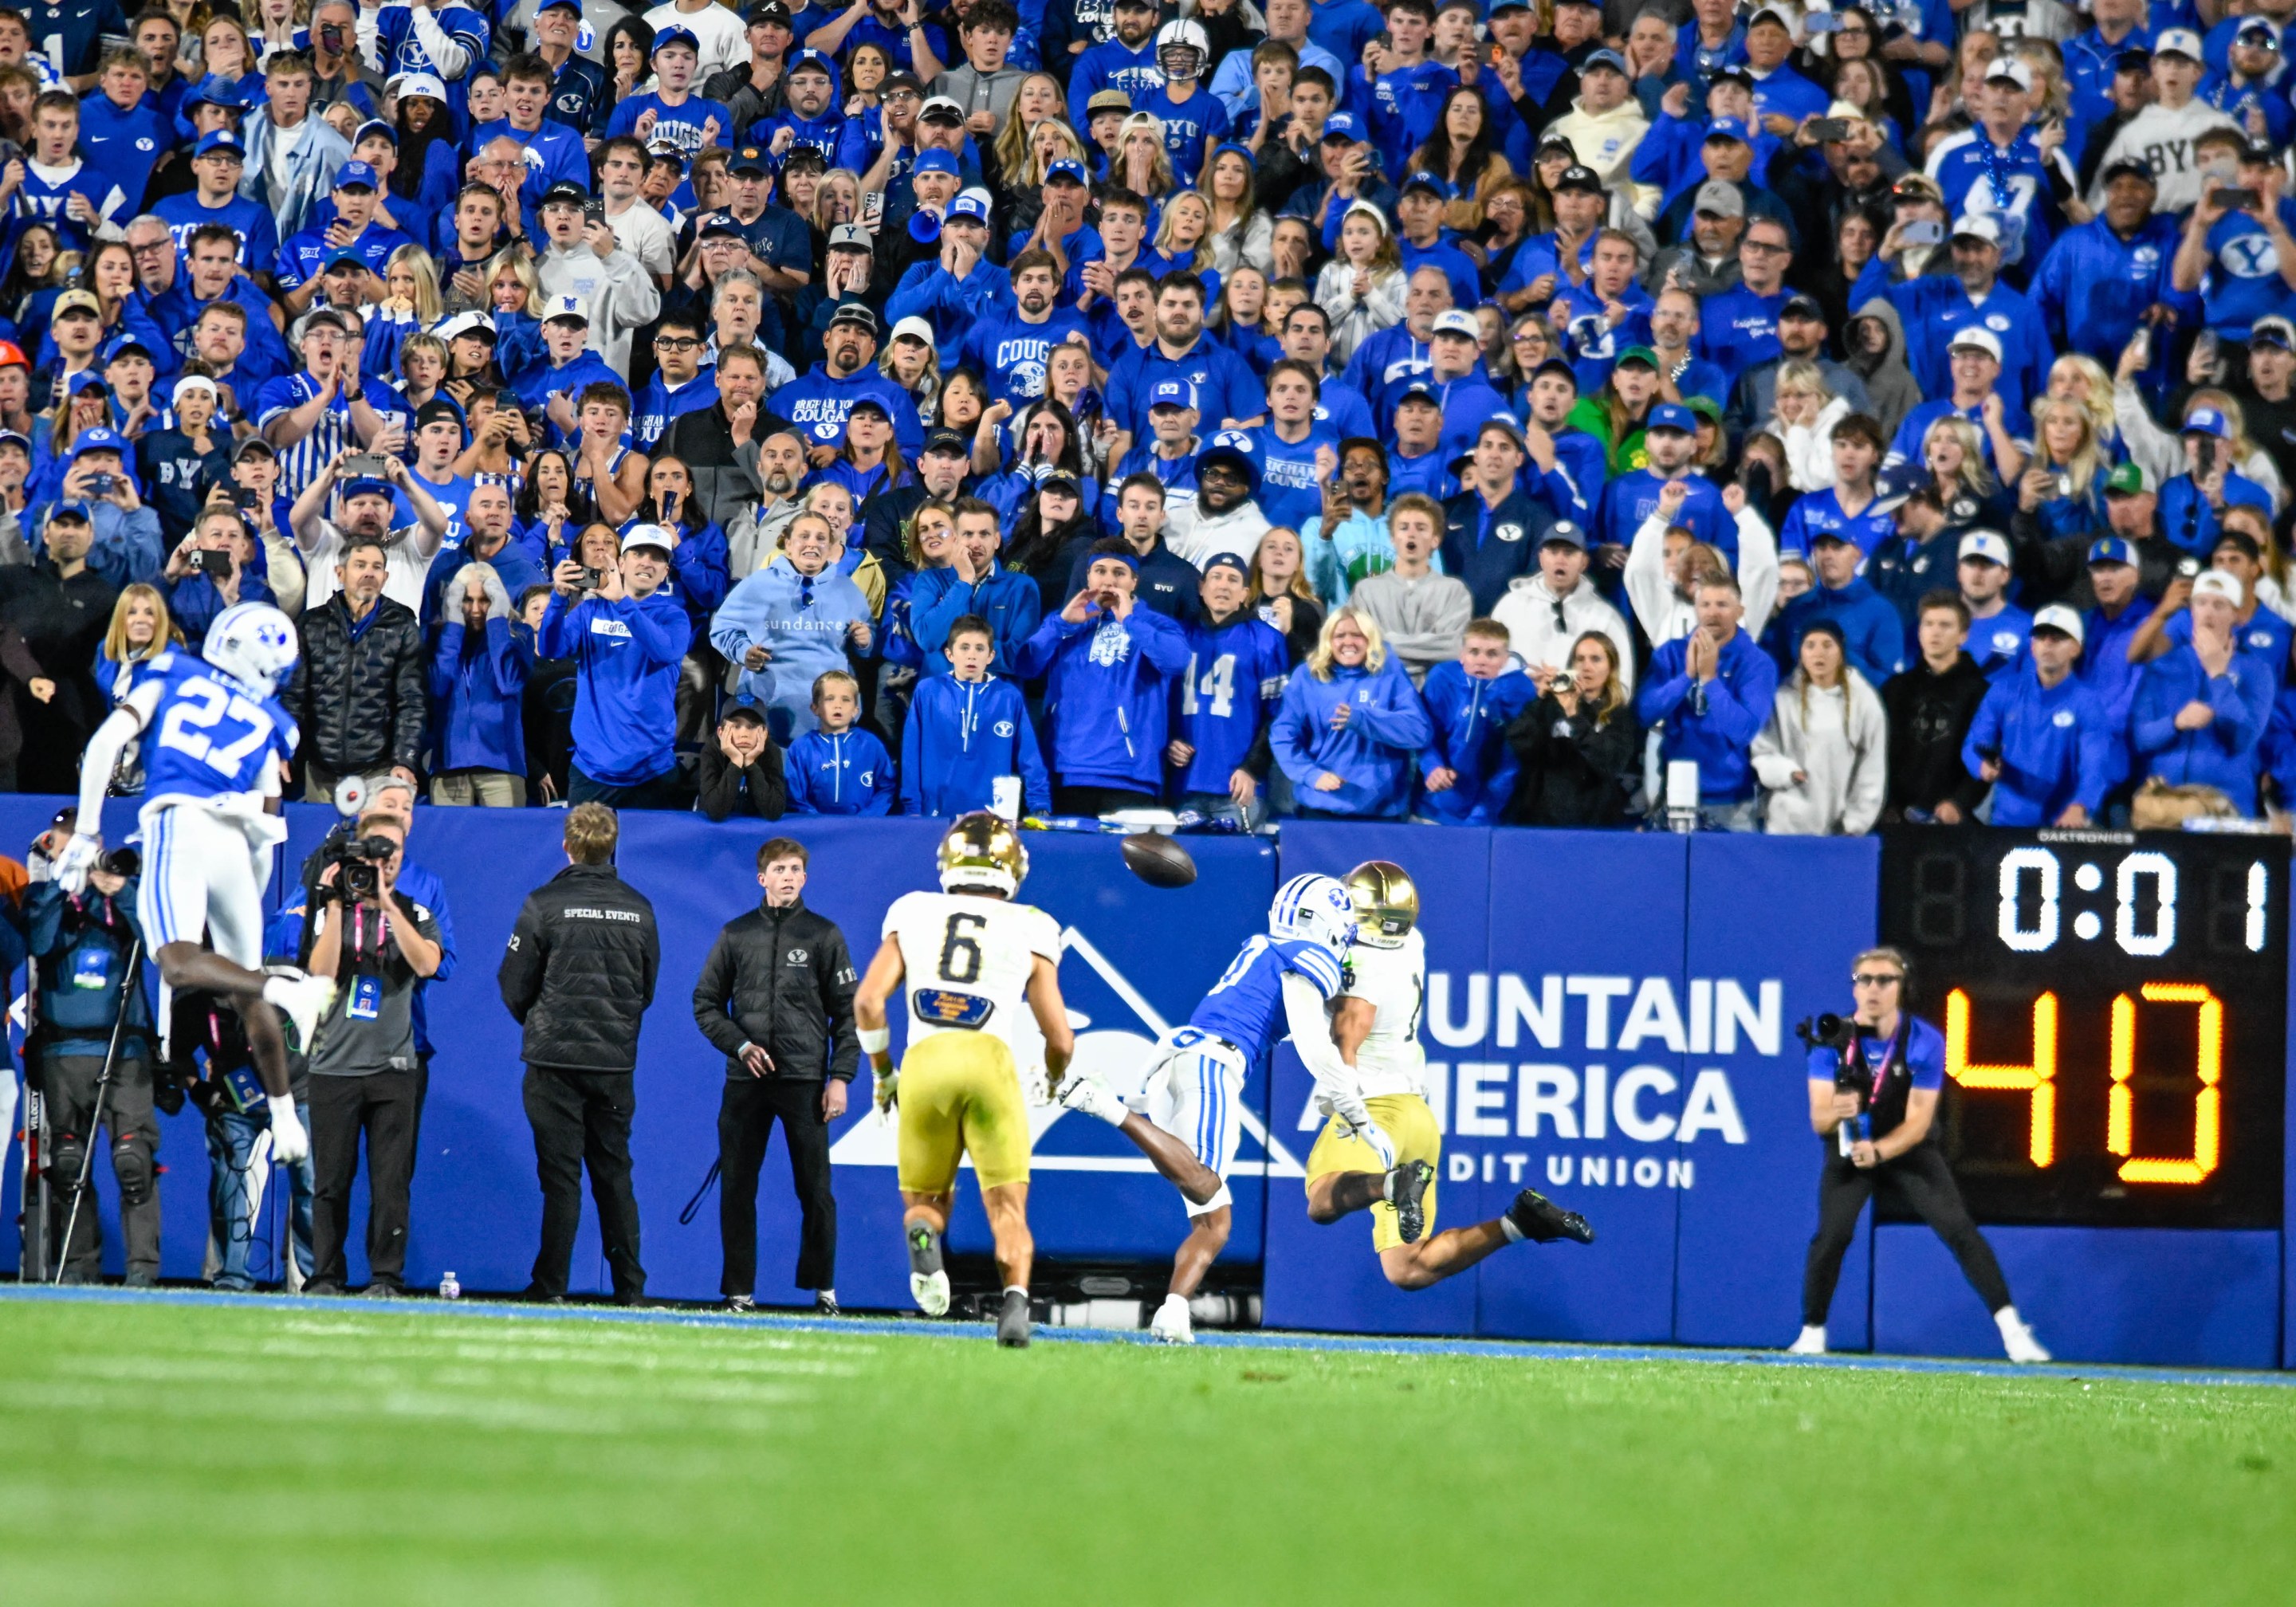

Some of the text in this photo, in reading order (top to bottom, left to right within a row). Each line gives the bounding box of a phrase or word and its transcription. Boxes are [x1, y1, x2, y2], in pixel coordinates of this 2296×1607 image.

[558, 95, 584, 113] Y
[648, 120, 706, 149] OUGS
[1161, 120, 1199, 137] YU
[136, 138, 154, 151] Y
[2144, 140, 2197, 176] BY
[845, 227, 856, 239] Y
[2228, 236, 2278, 276] Y
[997, 340, 1056, 368] COUG
[817, 424, 837, 438] Y
[1498, 525, 1520, 540] Y
[1154, 583, 1174, 592] BYU
[765, 615, 843, 632] sundance
[1183, 651, 1236, 719] 14
[159, 674, 273, 780] 27
[996, 722, 1012, 737] Y
[2037, 830, 2136, 845] DAKTRONICS
[1998, 847, 2267, 957] 0:01
[564, 908, 641, 923] SPECIAL EVENTS
[788, 950, 807, 962] Y
[938, 912, 986, 984] 6
[1426, 972, 1783, 1056] UNTAIN
[1944, 981, 2223, 1185] 40
[1449, 1153, 1694, 1189] DIT UNION
